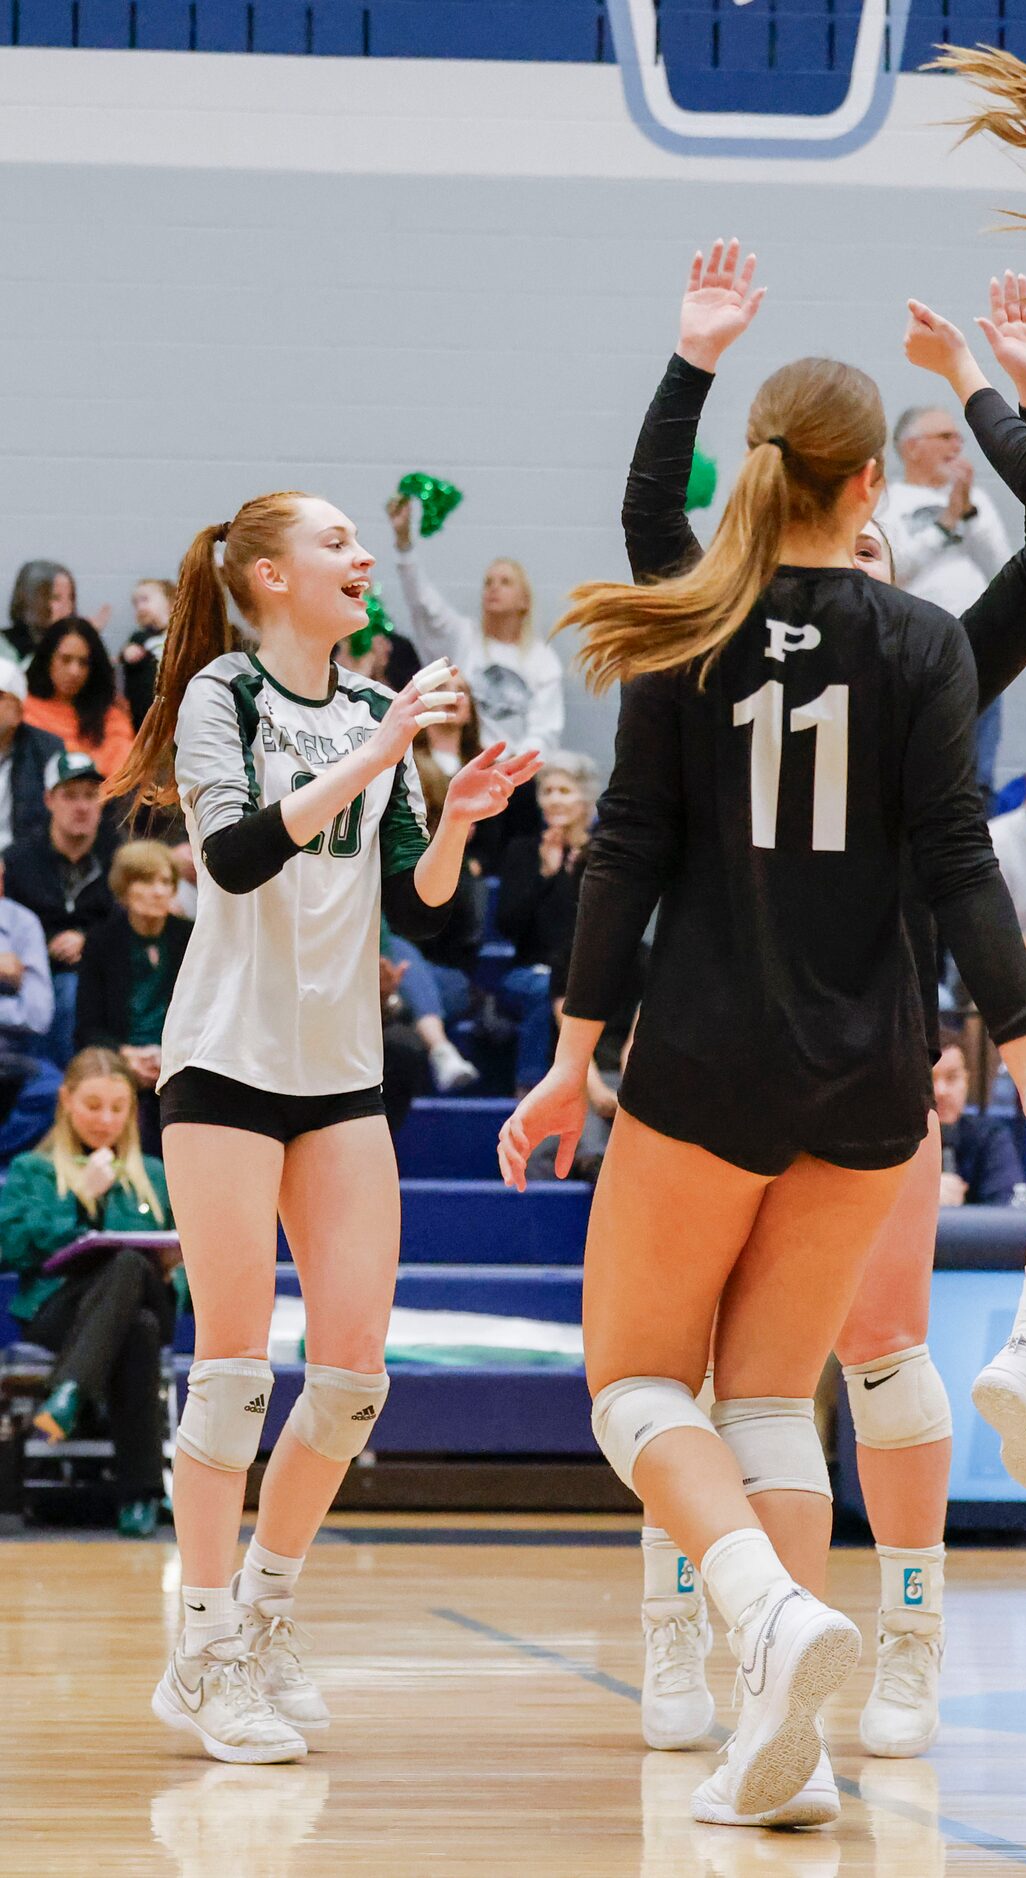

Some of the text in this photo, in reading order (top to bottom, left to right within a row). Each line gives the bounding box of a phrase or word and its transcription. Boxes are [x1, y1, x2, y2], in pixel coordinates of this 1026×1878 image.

[764, 617, 822, 663] P
[259, 716, 378, 765] EAGLE
[732, 679, 849, 852] 11
